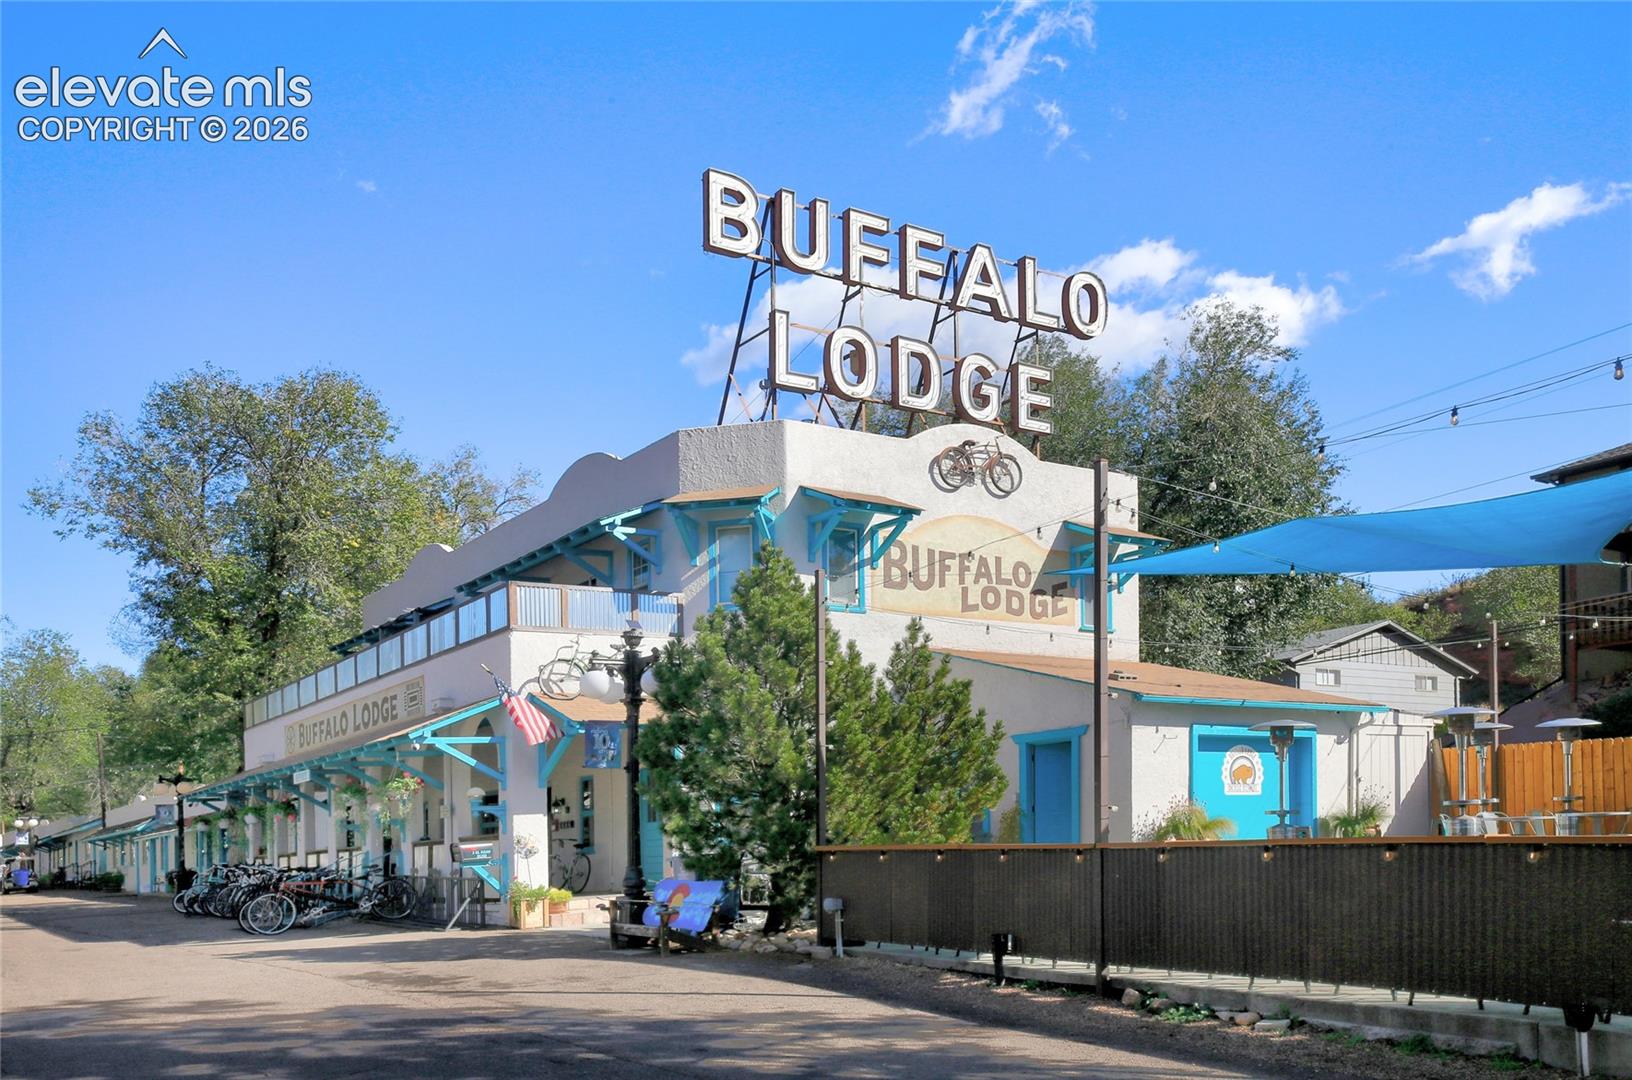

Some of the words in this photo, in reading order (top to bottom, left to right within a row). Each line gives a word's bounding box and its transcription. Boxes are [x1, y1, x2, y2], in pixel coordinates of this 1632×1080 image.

[703, 167, 1108, 340] BUFFALO
[769, 309, 1054, 435] LODGE
[882, 536, 1033, 591] BUFFALO
[960, 580, 1069, 620] LODGE
[299, 710, 348, 748] BUFFALO
[353, 694, 399, 733] LODGE
